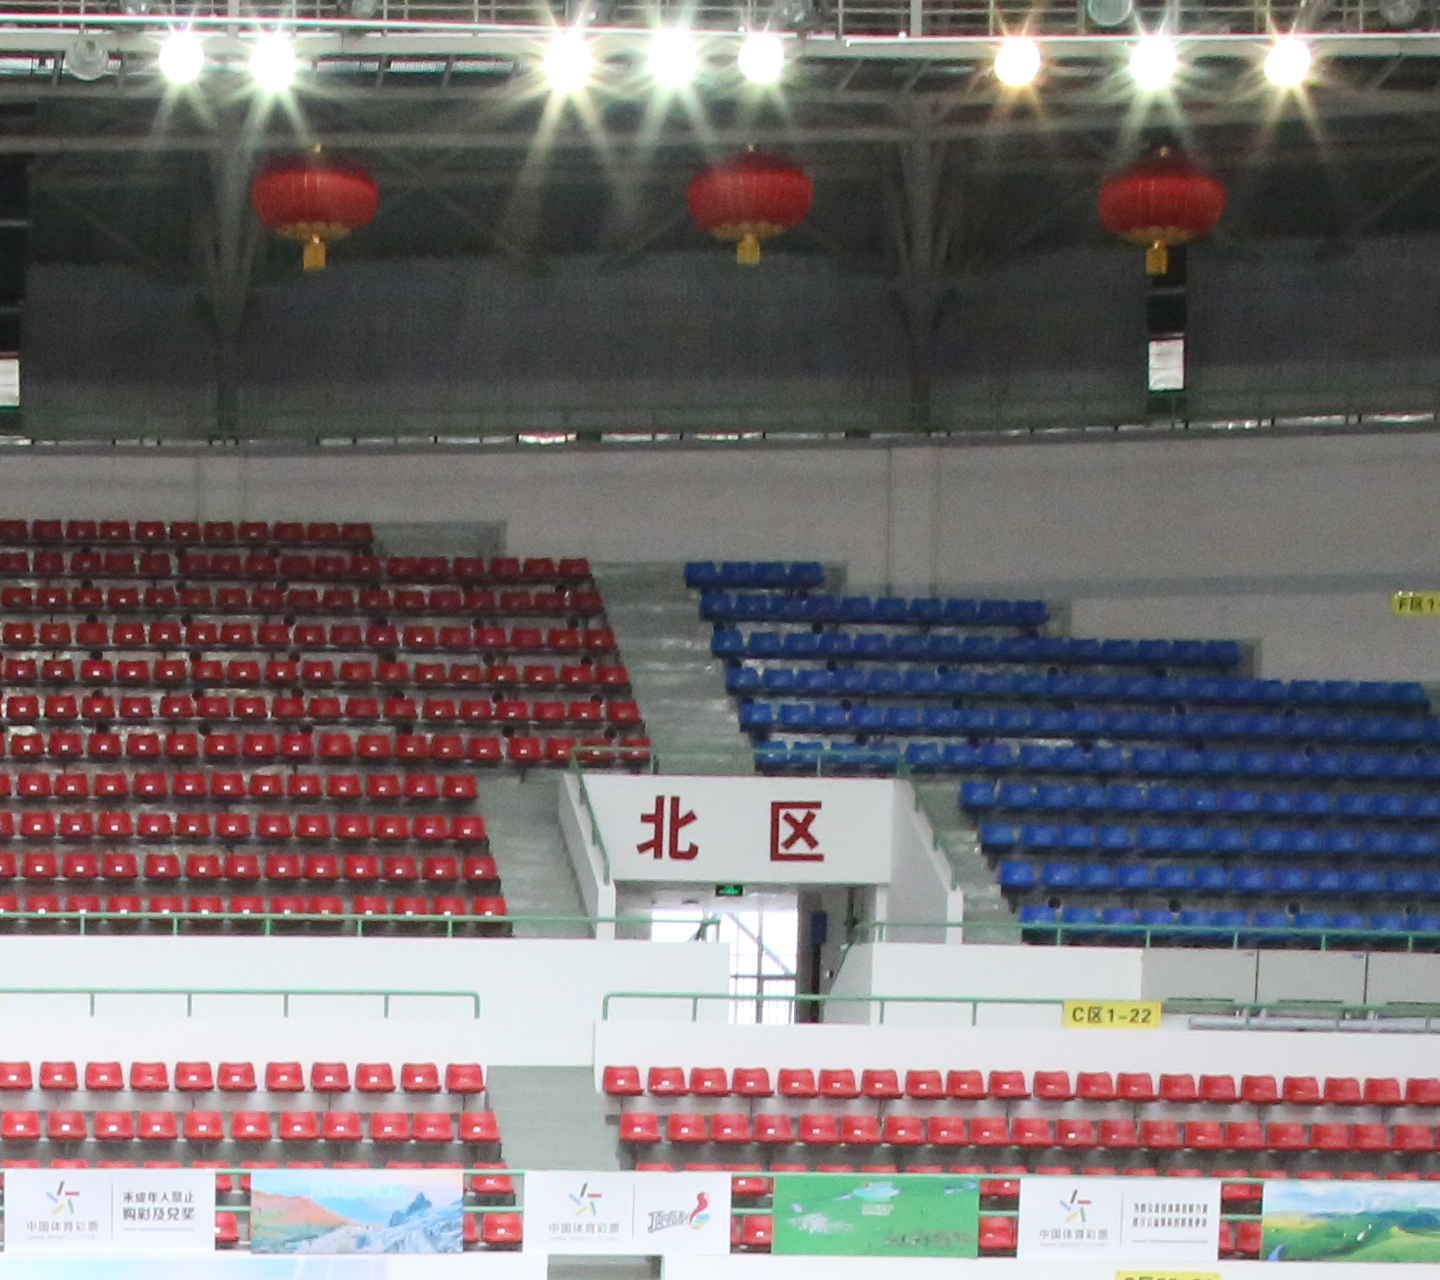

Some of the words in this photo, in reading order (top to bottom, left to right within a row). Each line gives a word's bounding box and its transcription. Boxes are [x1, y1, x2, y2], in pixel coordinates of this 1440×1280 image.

[636, 795, 825, 862] 北区
[1071, 1004, 1155, 1025] C区1-22
[123, 1191, 195, 1203] 未成年人禁止
[26, 1220, 99, 1233] 中国体育彩票
[548, 1222, 620, 1235] 中国体育彩票
[1039, 1228, 1109, 1240] 中国体育彩票
